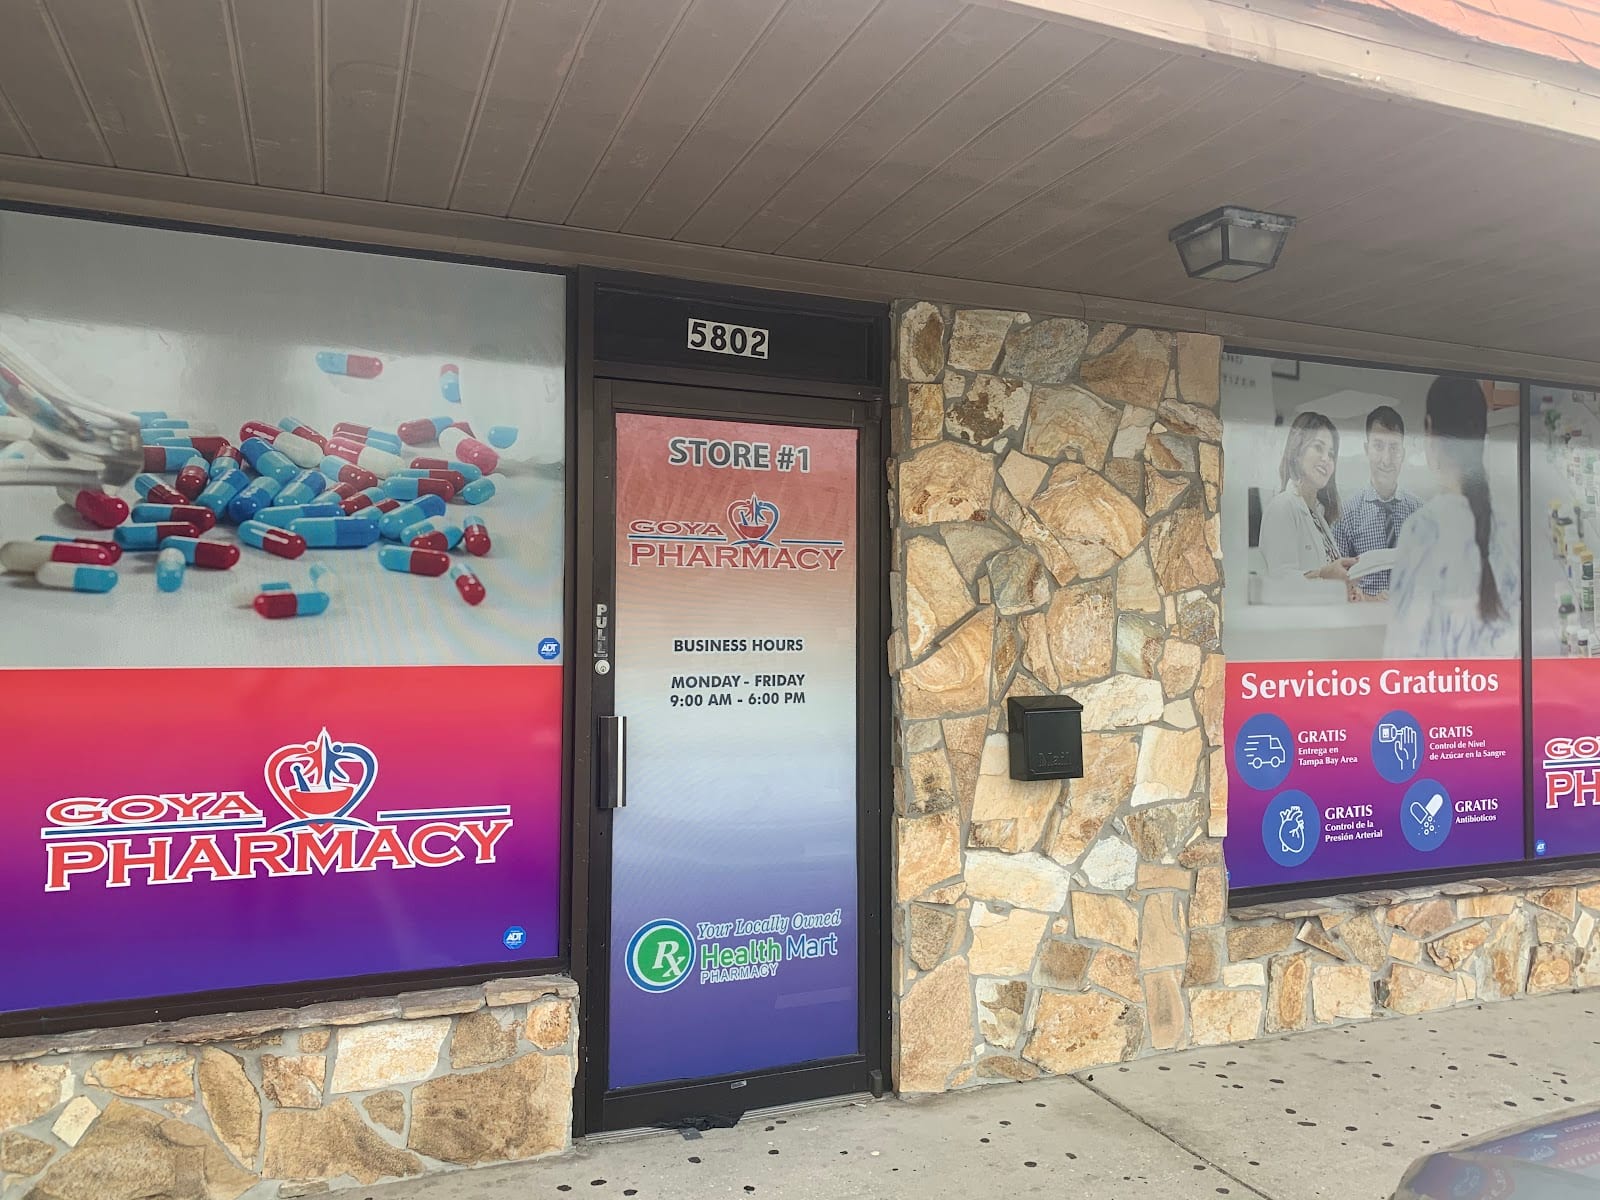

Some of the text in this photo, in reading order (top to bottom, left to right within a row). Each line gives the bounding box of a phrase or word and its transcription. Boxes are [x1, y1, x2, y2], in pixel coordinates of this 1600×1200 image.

[690, 321, 766, 357] 5802
[669, 438, 810, 472] STORE #1
[629, 519, 726, 536] GOYA
[629, 543, 844, 571] PHARMACY
[541, 643, 558, 652] ADT
[674, 639, 803, 652] BUSINESS HOURS
[671, 675, 741, 689] MONDAY
[754, 674, 805, 687] FRIDAY
[1241, 666, 1499, 700] Servicios Gratuitos
[670, 694, 703, 707] 9:00
[708, 693, 732, 706] AM
[748, 692, 780, 705] 6:00
[784, 692, 806, 704] PM
[1298, 729, 1347, 744] GRATIS
[1429, 725, 1473, 739] GRATIS
[1298, 747, 1328, 757] Entrega
[1429, 740, 1456, 750] Control
[1457, 740, 1467, 749] de
[1544, 736, 1600, 760] GO
[1298, 755, 1358, 768] Tampa Bay Area
[1429, 752, 1439, 761] de
[1440, 751, 1464, 760] Azúcar
[1475, 750, 1482, 758] la
[1483, 749, 1507, 759] Sangre
[46, 791, 264, 826] GOYA
[1324, 804, 1373, 820] GRATIS
[1454, 798, 1498, 813] GRATIS
[1325, 819, 1374, 832] Control de la
[1325, 829, 1383, 843] Presión Arterial
[44, 818, 513, 892] PHARMACY
[697, 908, 841, 940] Your Locally Owned
[506, 932, 524, 941] ADT
[701, 933, 838, 970] Health Mart
[700, 963, 779, 984] PHARMACY
